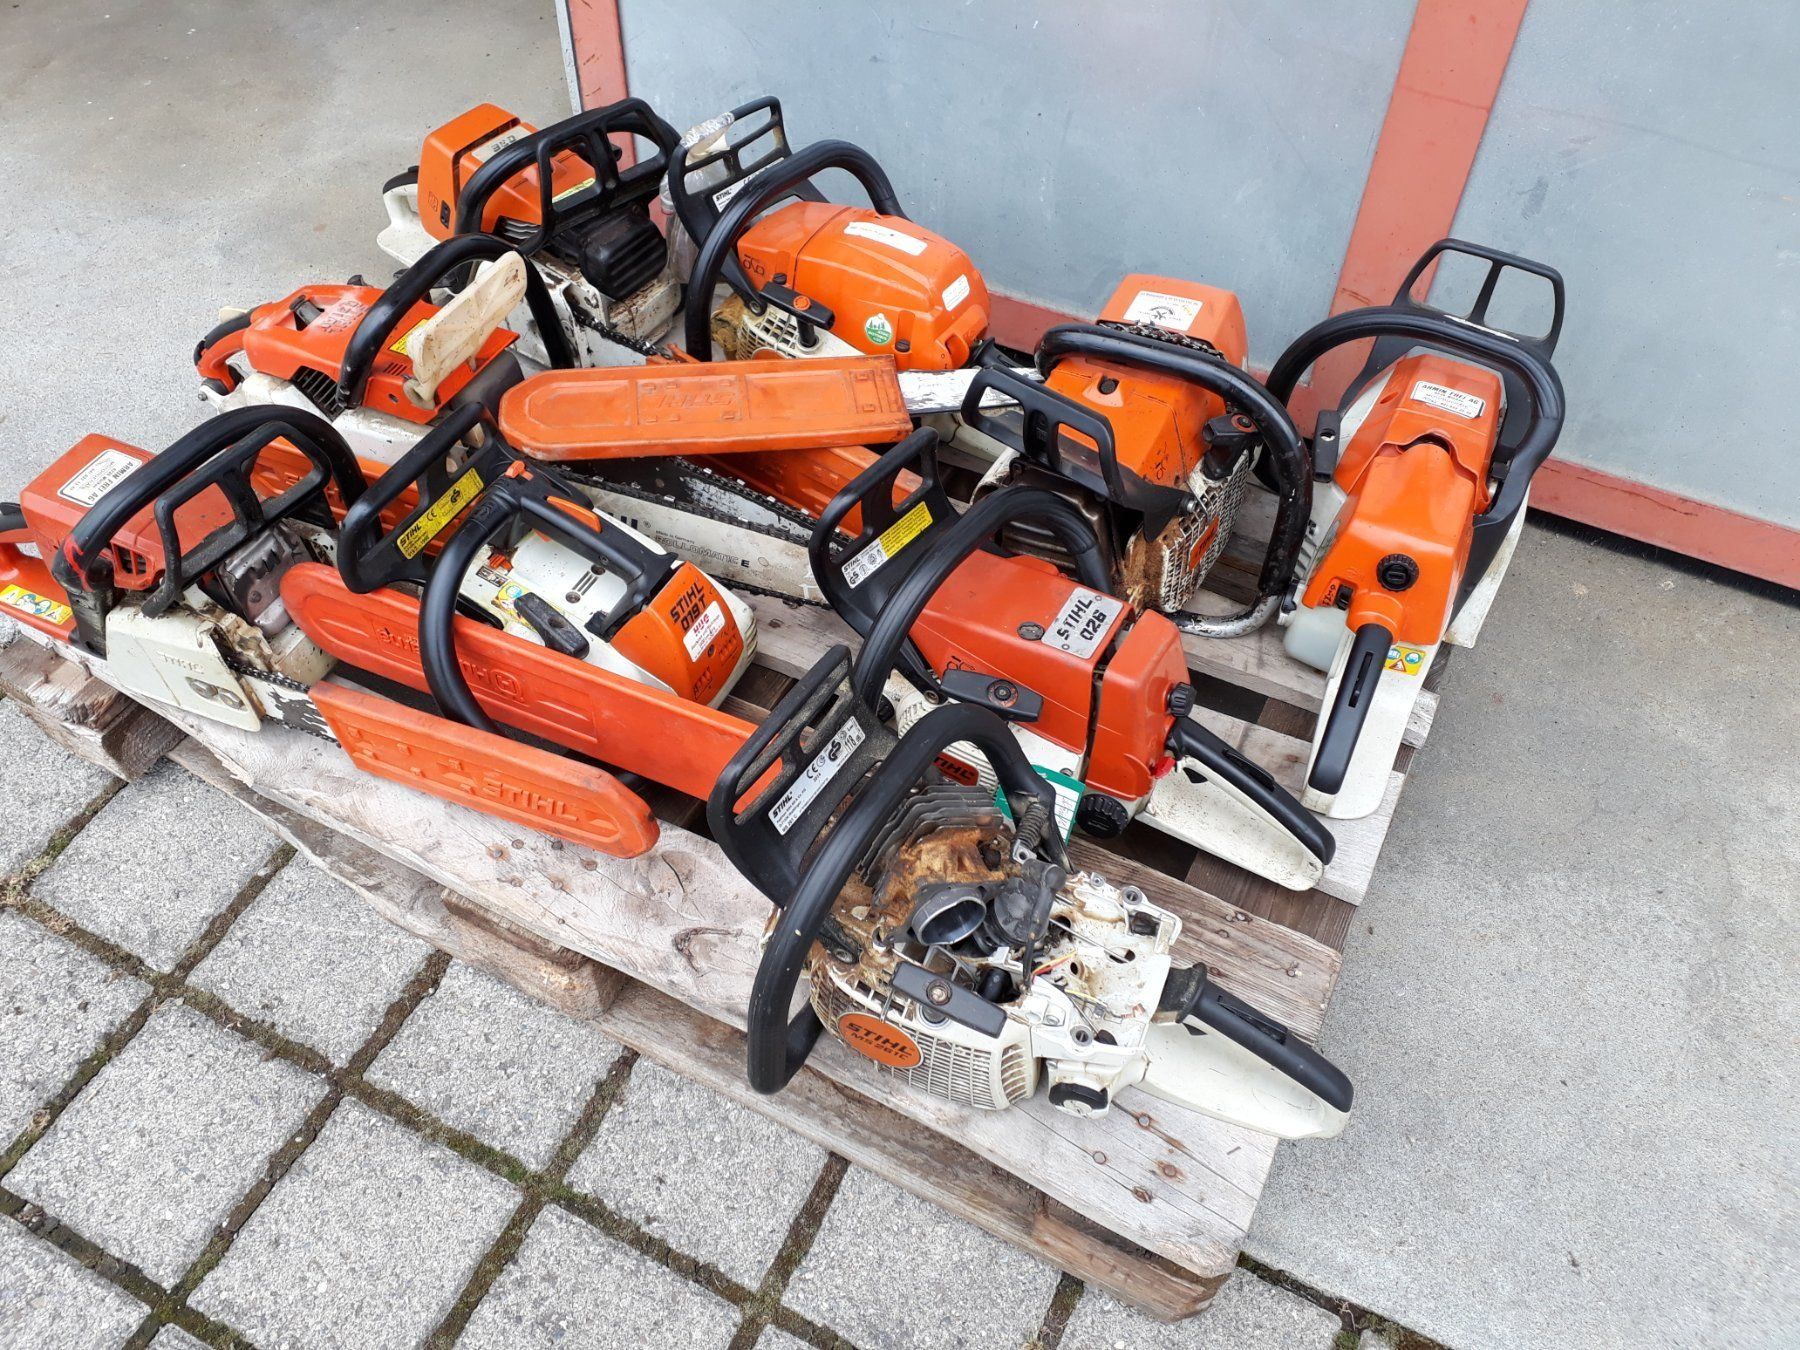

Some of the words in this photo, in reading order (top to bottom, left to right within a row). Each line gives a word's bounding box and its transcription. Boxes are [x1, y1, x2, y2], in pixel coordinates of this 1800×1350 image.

[112, 461, 133, 479] ARMIN
[400, 523, 422, 547] STIHL
[843, 556, 860, 573] STIHL
[670, 582, 704, 624] STIHL
[1057, 599, 1093, 640] STIHL
[1080, 609, 1107, 641] 026
[482, 772, 578, 821] STIHL
[772, 795, 793, 818] STIHL
[847, 1022, 912, 1056] STIHL
